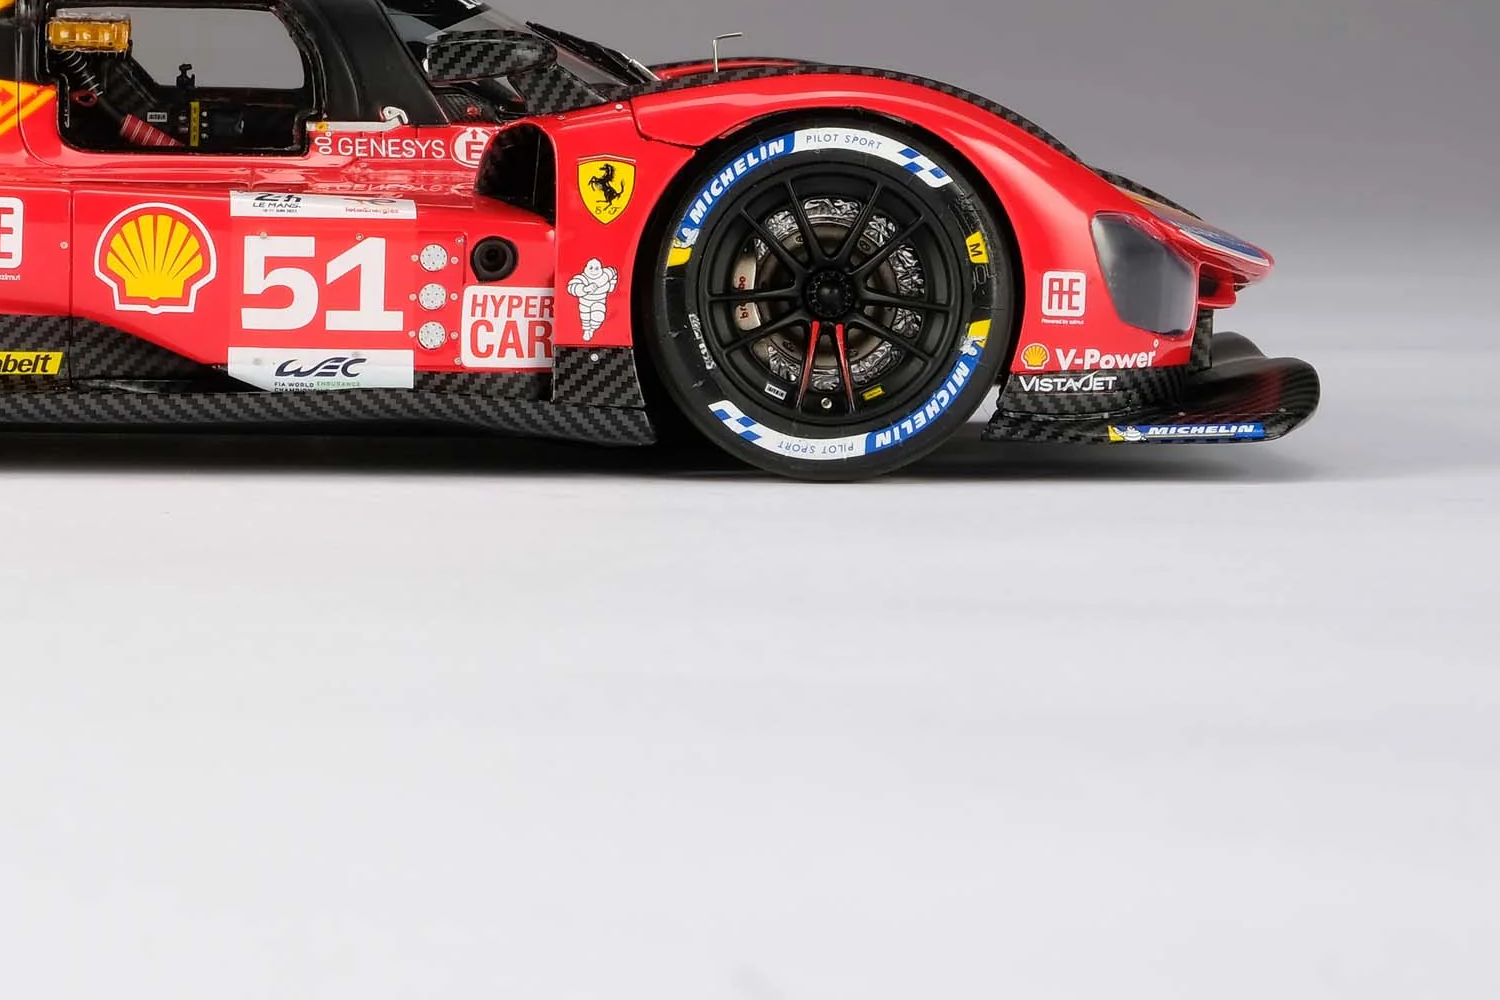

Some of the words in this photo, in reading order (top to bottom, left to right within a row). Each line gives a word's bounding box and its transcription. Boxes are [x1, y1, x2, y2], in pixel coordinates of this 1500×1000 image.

[337, 137, 445, 159] GENESYS
[806, 134, 838, 143] PILOT
[844, 134, 882, 150] SPORT
[689, 138, 785, 225] MICHELIN
[969, 243, 982, 257] M
[241, 235, 404, 331] 51
[470, 294, 554, 318] HYPER
[470, 320, 552, 359] CAR
[275, 357, 367, 377] WEC
[1055, 348, 1156, 370] V-Power
[876, 361, 969, 449] MICHELIN
[1148, 424, 1255, 435] MICHELIN
[778, 440, 815, 454] SPORT
[822, 442, 854, 454] PILOT
